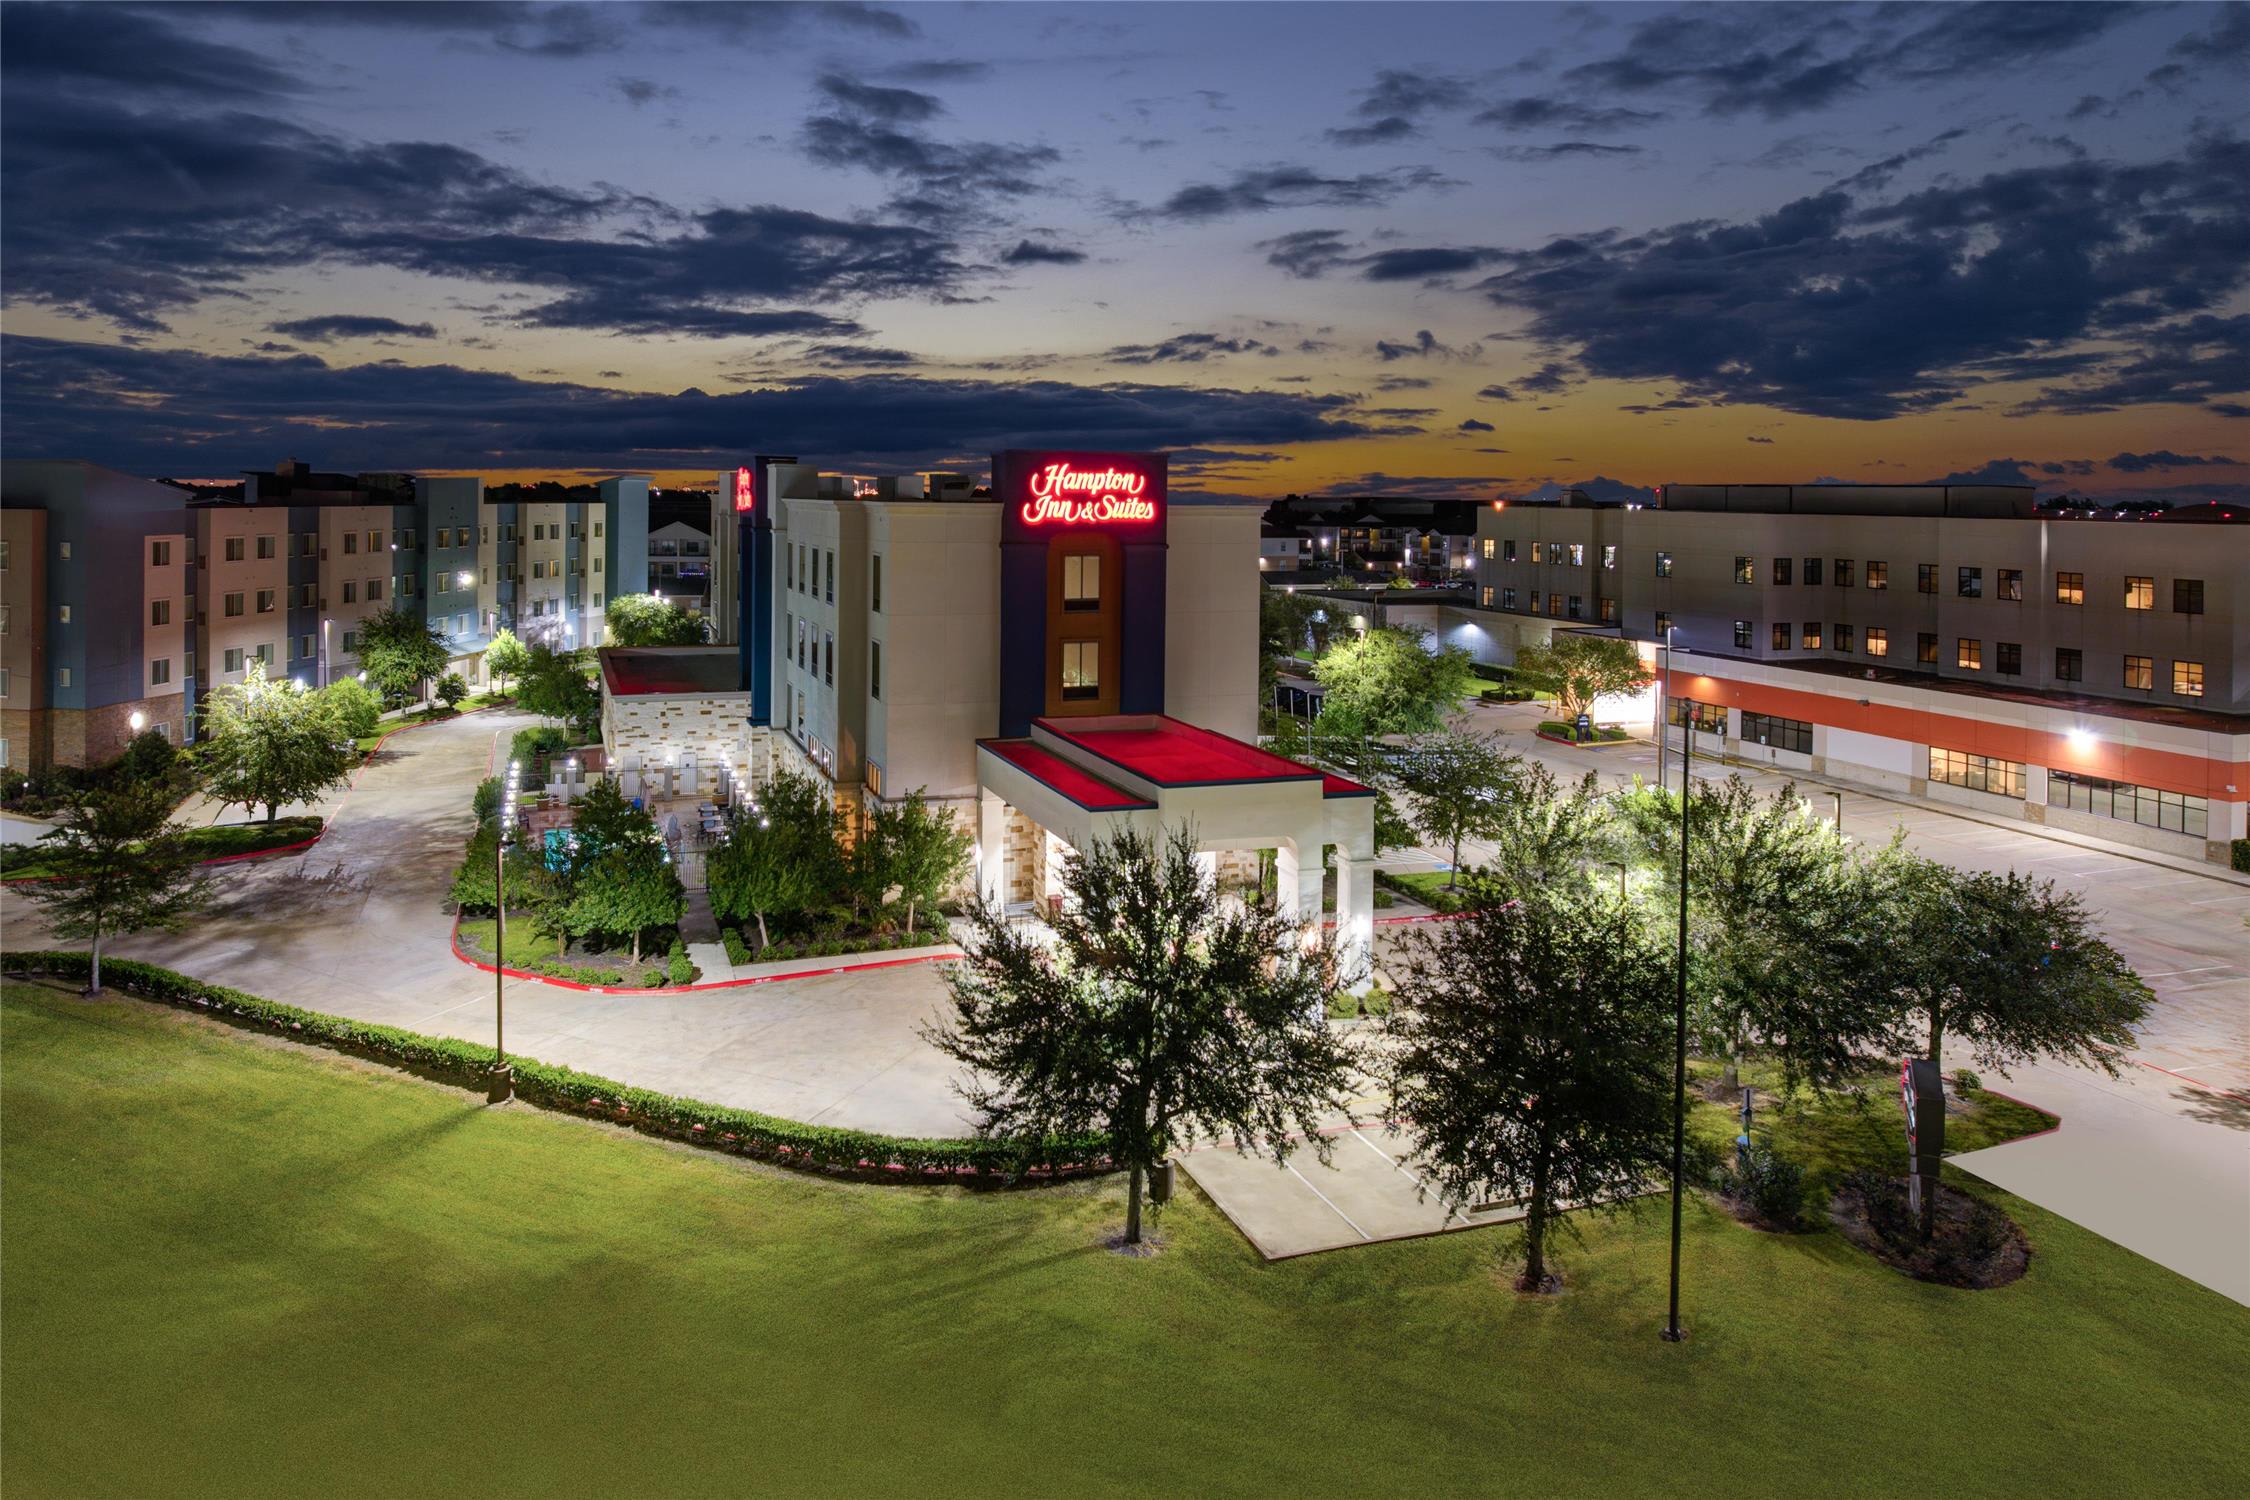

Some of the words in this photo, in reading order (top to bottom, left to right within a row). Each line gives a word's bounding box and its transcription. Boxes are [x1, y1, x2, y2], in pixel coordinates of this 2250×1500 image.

[1031, 463, 1145, 496] Hampton
[1023, 495, 1081, 522] Inn
[1081, 503, 1097, 521] &
[1094, 494, 1154, 521] Suites
